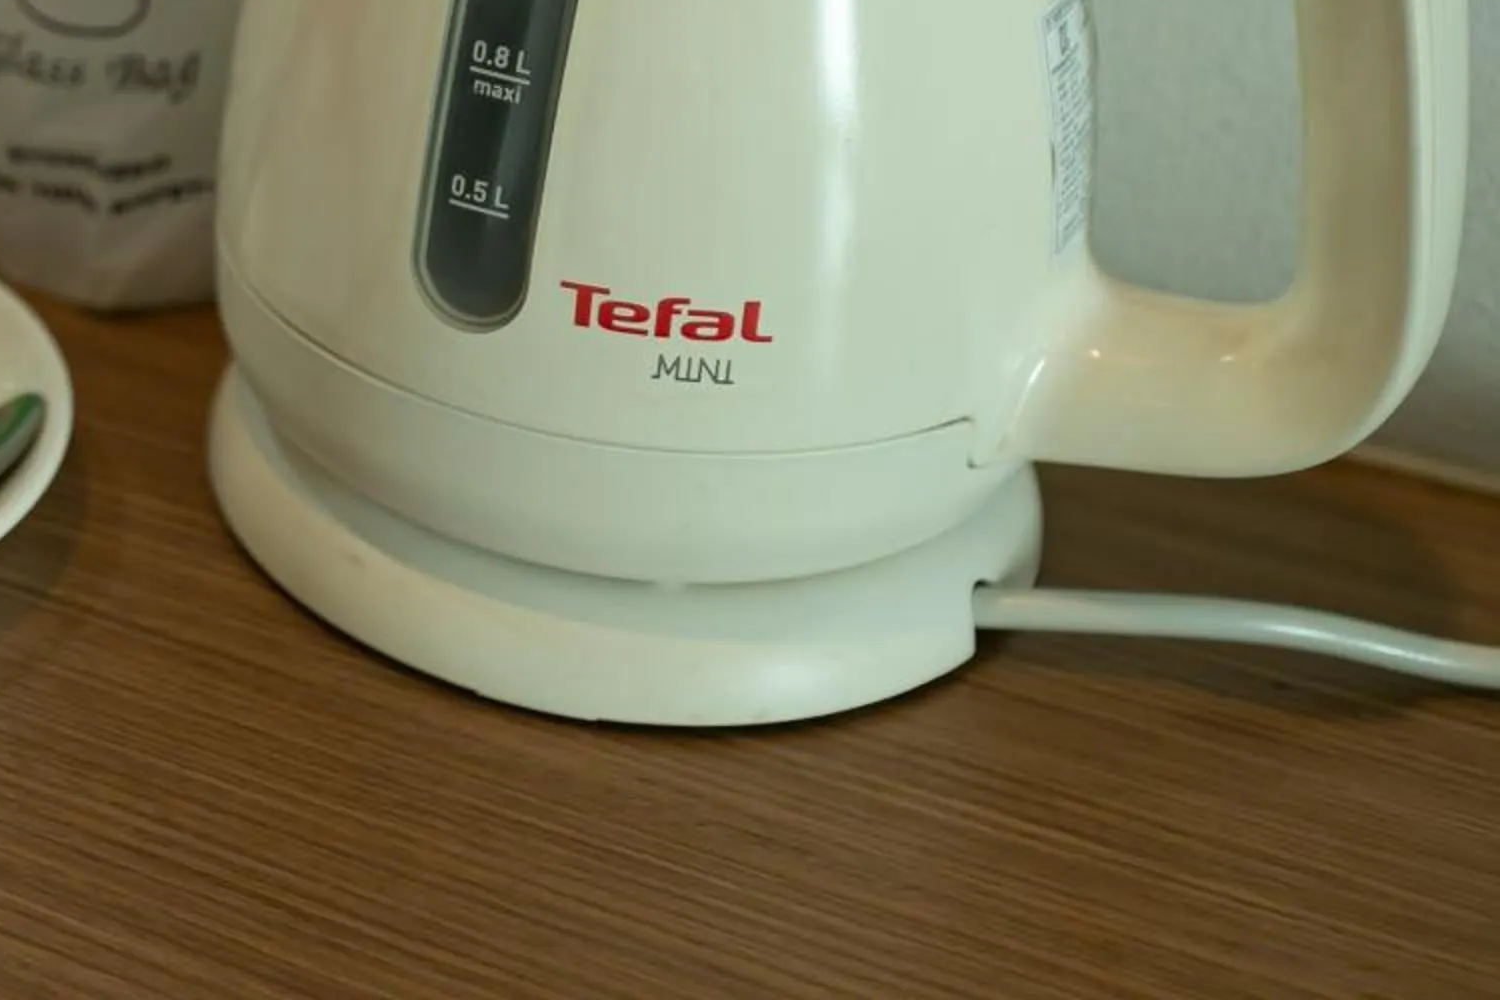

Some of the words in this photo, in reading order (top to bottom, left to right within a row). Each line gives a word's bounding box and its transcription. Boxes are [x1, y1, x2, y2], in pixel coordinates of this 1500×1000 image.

[472, 39, 509, 70] 0.8
[516, 50, 531, 75] L
[473, 78, 522, 104] maxi
[451, 173, 489, 203] 0.5
[495, 186, 510, 210] L
[559, 279, 773, 343] Tefal
[650, 352, 735, 385] MINI
